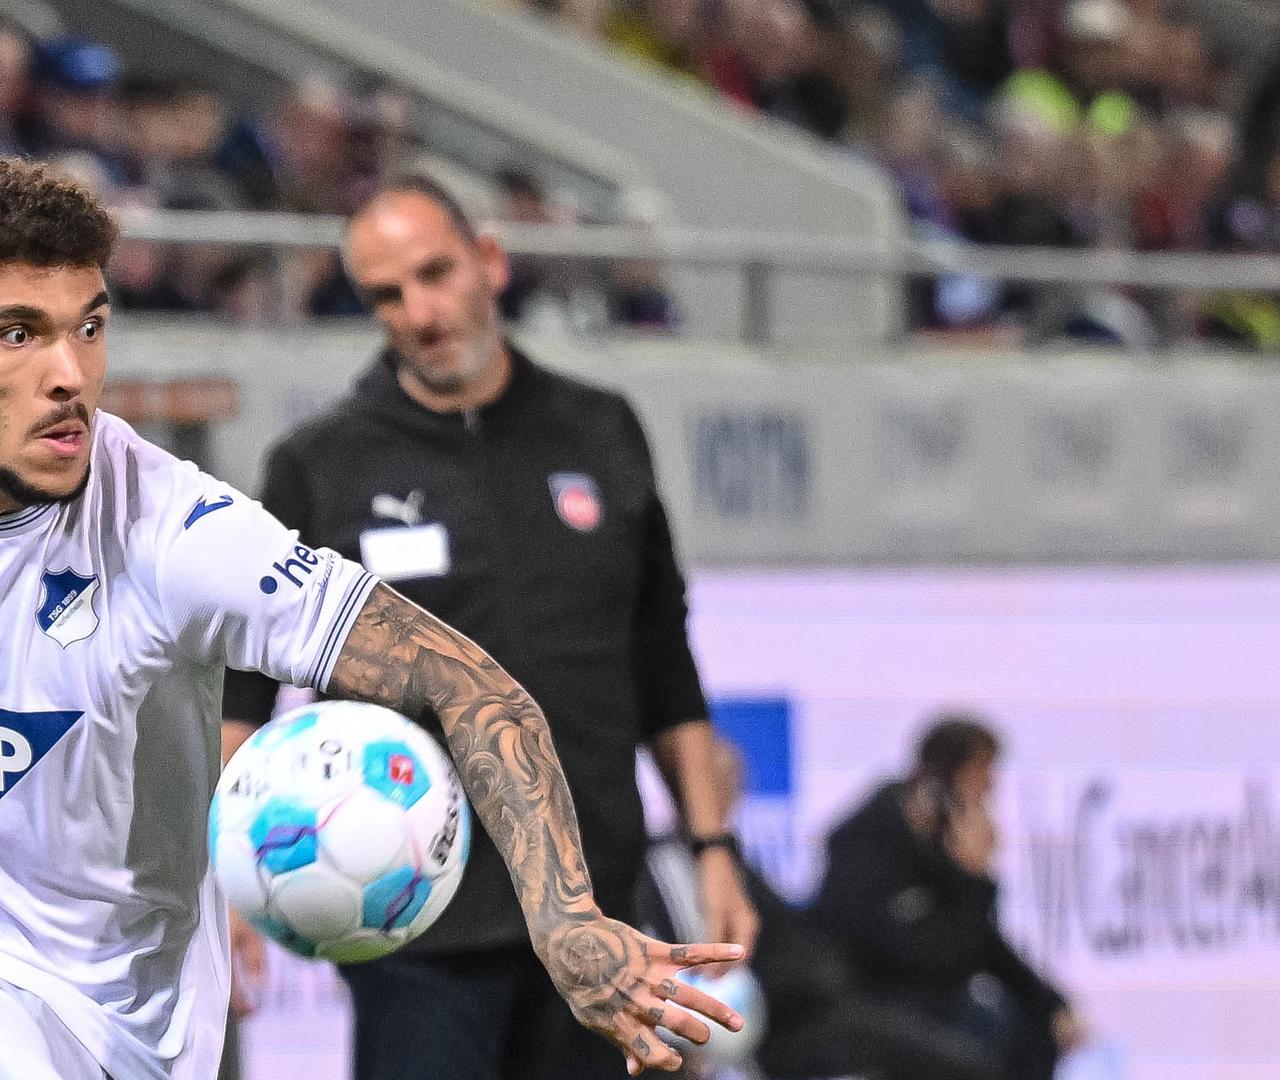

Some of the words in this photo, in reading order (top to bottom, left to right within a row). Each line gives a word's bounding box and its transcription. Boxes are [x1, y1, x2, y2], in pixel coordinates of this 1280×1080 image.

[272, 545, 325, 589] he
[47, 604, 64, 622] TSG
[61, 588, 78, 607] 1899
